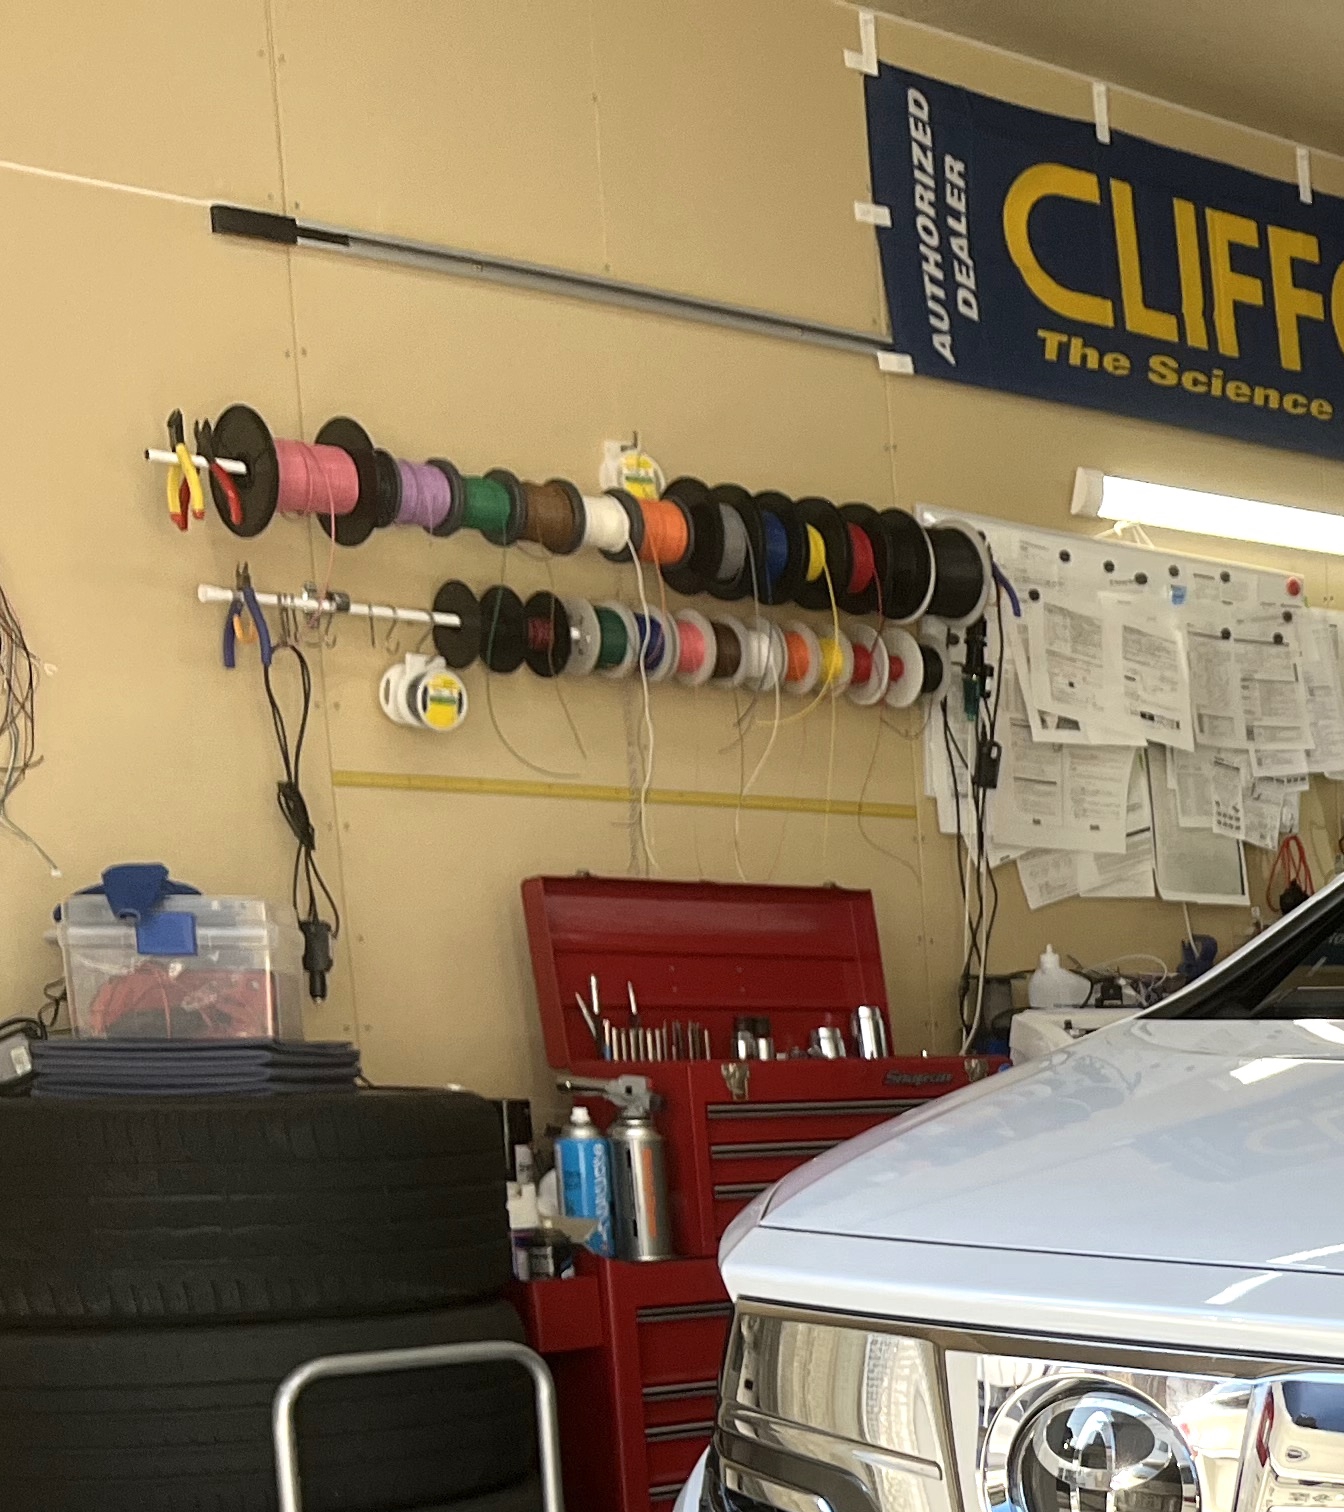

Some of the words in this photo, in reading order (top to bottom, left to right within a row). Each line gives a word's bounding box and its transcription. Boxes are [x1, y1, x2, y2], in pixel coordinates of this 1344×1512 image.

[907, 87, 956, 367] AUTHORIZED
[944, 154, 980, 322] DEALER
[1037, 328, 1131, 377] The
[1147, 354, 1334, 421] Science
